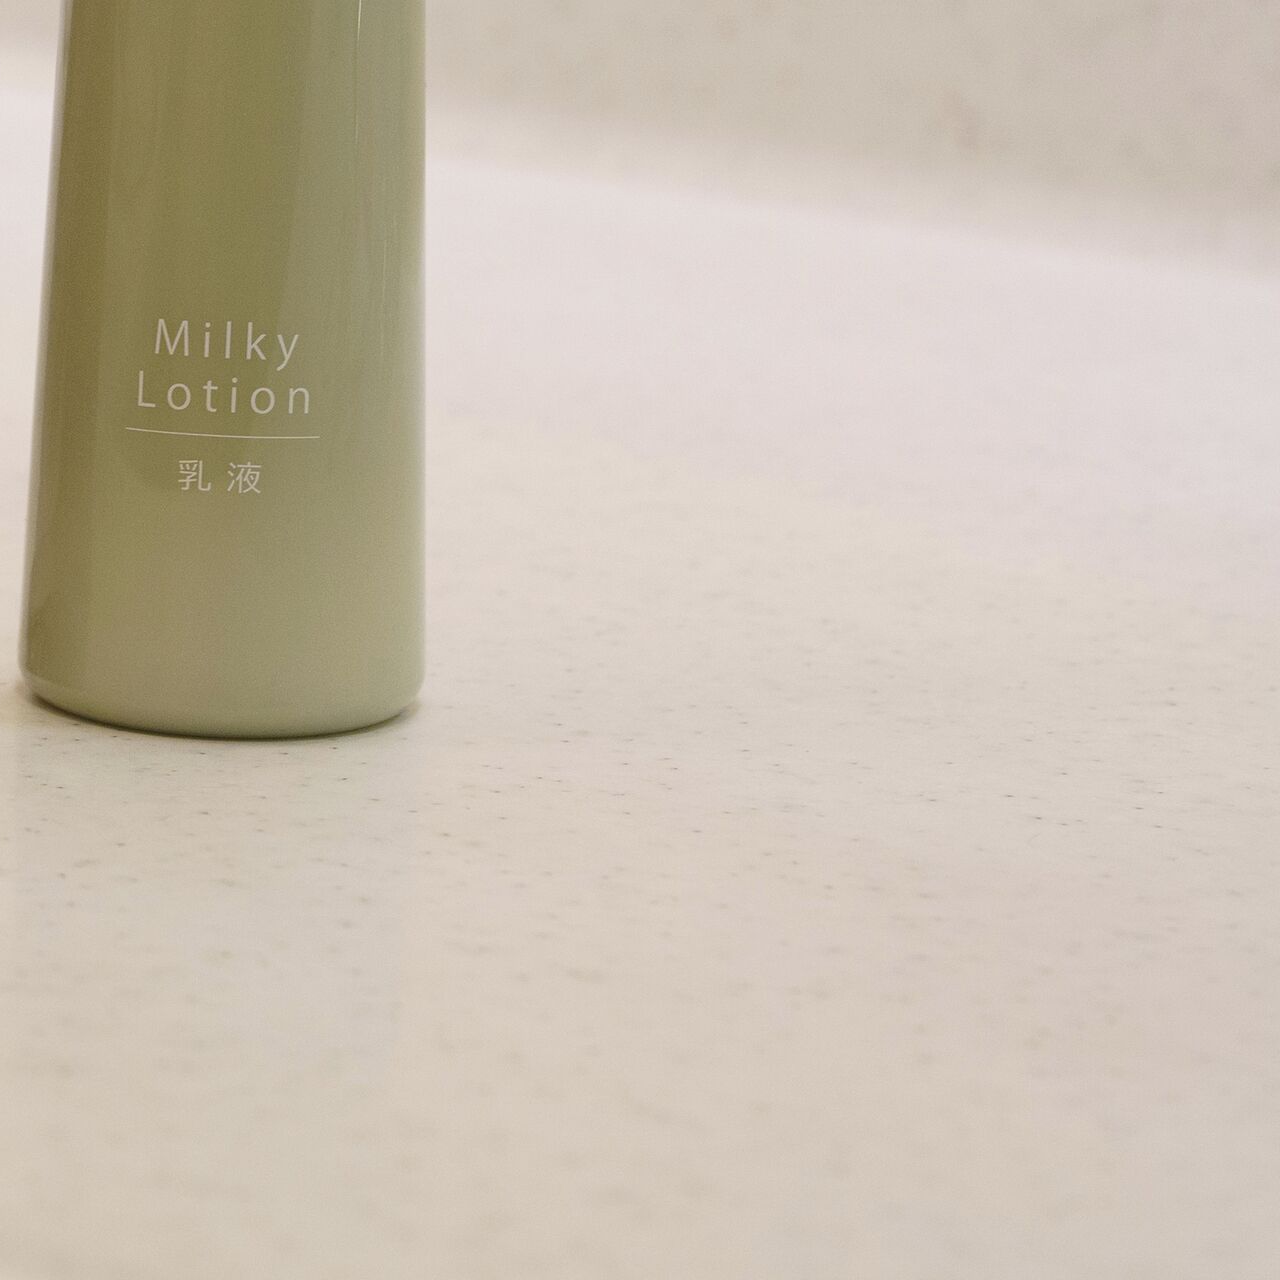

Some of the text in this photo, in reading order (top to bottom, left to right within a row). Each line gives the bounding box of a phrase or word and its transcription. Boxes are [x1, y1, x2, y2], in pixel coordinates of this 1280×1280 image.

[153, 317, 300, 372] Milky
[136, 369, 311, 415] Lotion
[177, 459, 263, 495] 乳液
